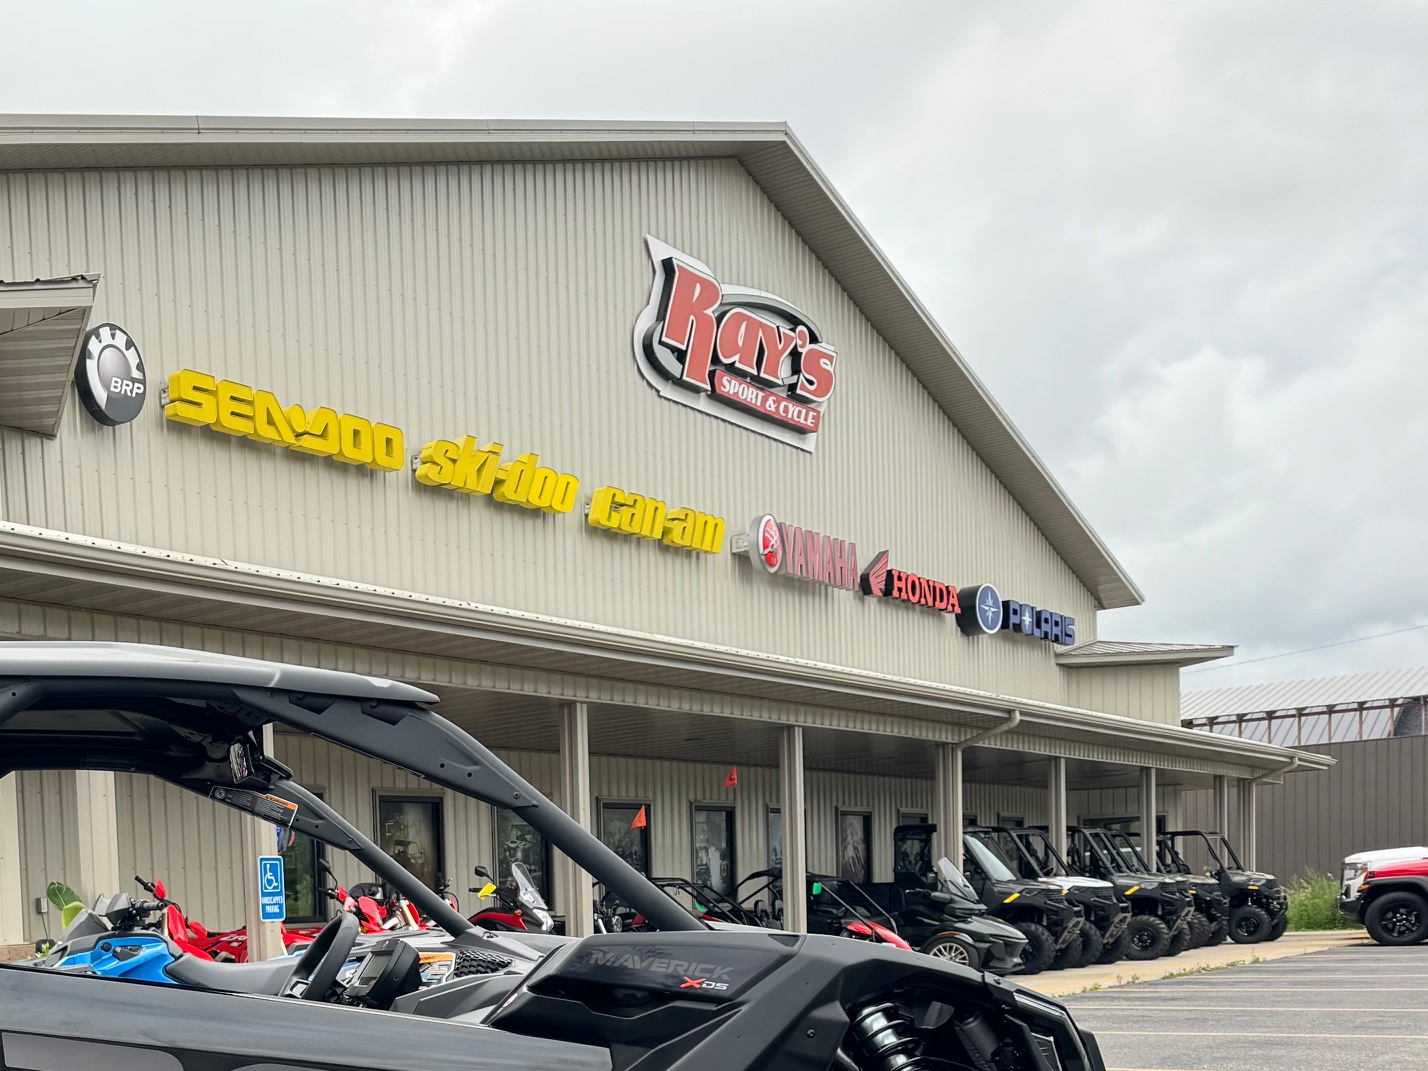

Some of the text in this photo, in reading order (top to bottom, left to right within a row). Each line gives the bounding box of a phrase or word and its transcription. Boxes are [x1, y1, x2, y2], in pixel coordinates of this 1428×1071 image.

[659, 257, 838, 403] Ray's
[109, 376, 145, 399] BRP
[720, 376, 818, 428] SPORT & CYCLE
[778, 521, 860, 592] YAMAHA
[890, 569, 962, 614] HONDA
[1001, 599, 1076, 646] POLARIS
[589, 951, 735, 980] MAVERICK
